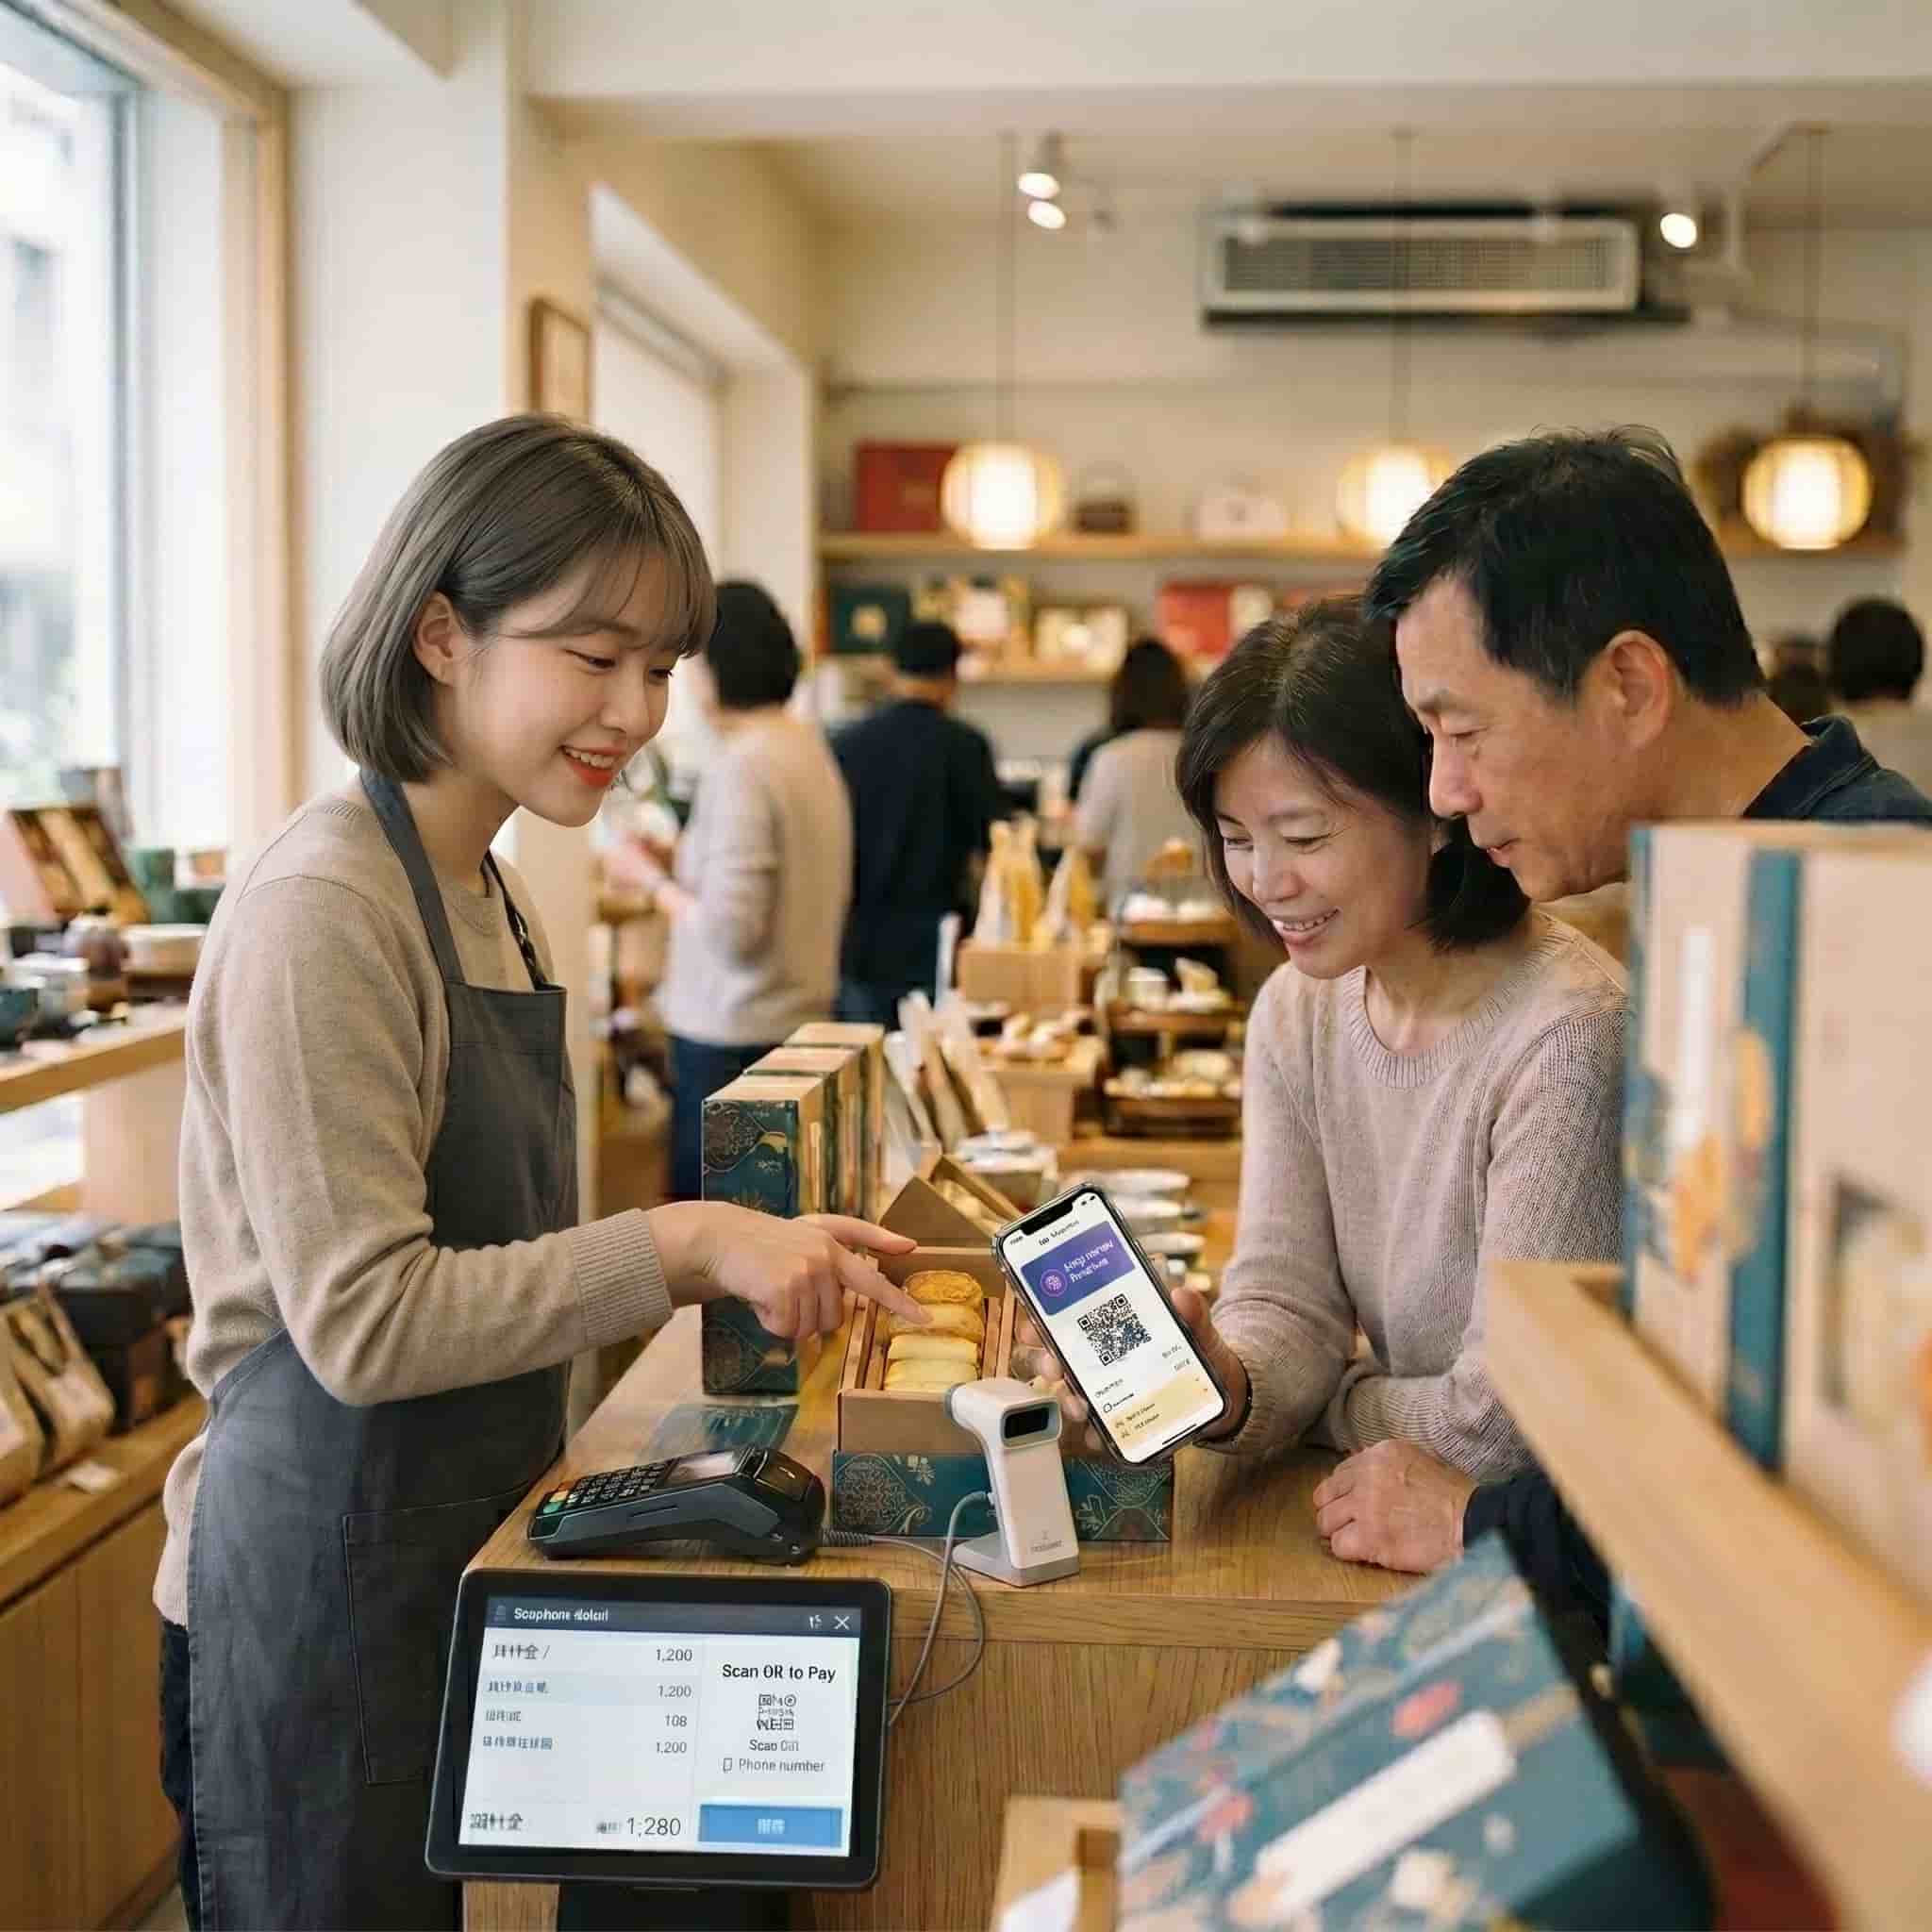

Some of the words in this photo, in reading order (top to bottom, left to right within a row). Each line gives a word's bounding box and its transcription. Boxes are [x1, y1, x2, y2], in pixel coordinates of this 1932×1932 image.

[722, 1664, 758, 1679] Scan
[790, 1665, 804, 1680] to
[808, 1666, 837, 1683] Pay
[664, 1713, 688, 1727] 108
[739, 1758, 776, 1772] Phone
[779, 1759, 824, 1773] number
